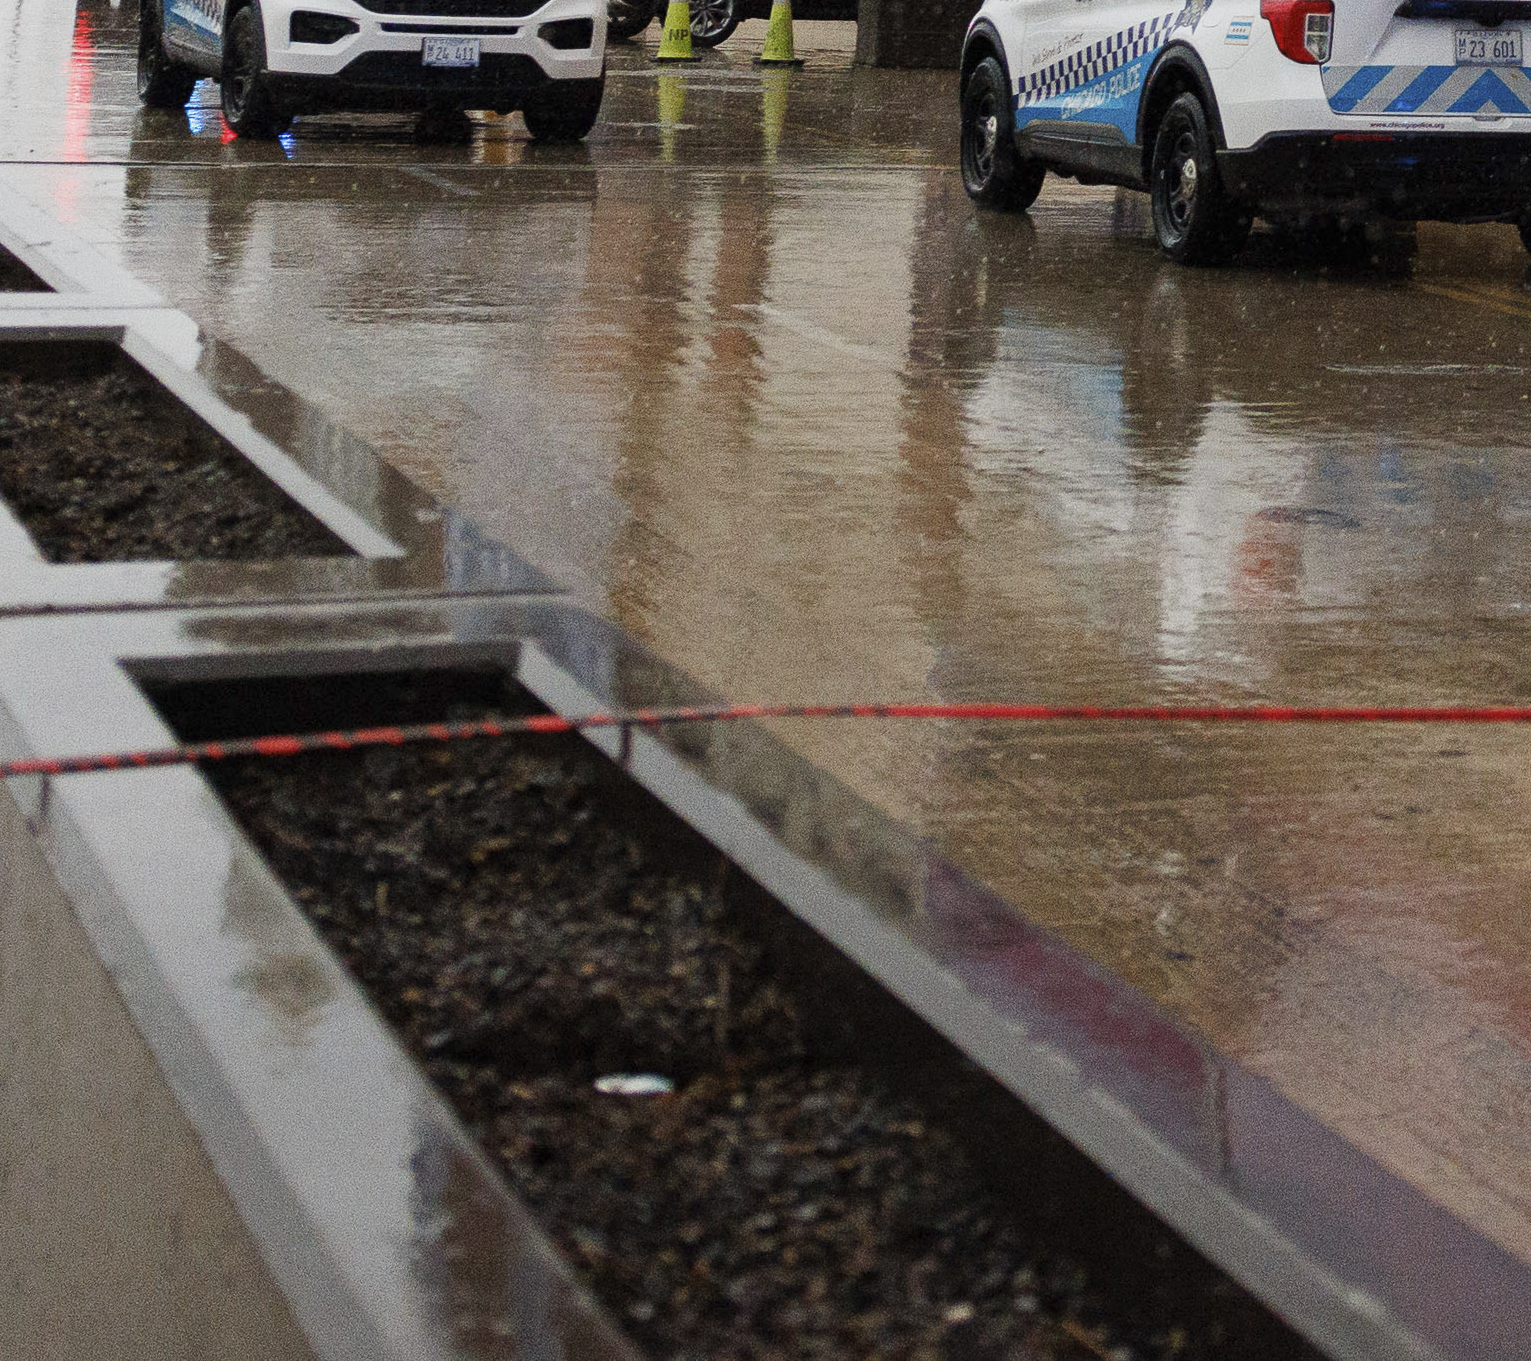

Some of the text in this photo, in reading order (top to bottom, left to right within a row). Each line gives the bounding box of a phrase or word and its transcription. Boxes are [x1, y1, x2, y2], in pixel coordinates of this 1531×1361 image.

[436, 47, 449, 60] 24
[455, 47, 475, 61] 411
[1470, 40, 1485, 58] 23
[1493, 40, 1517, 58] 601
[1061, 62, 1142, 120] CHICAGO POLICE
